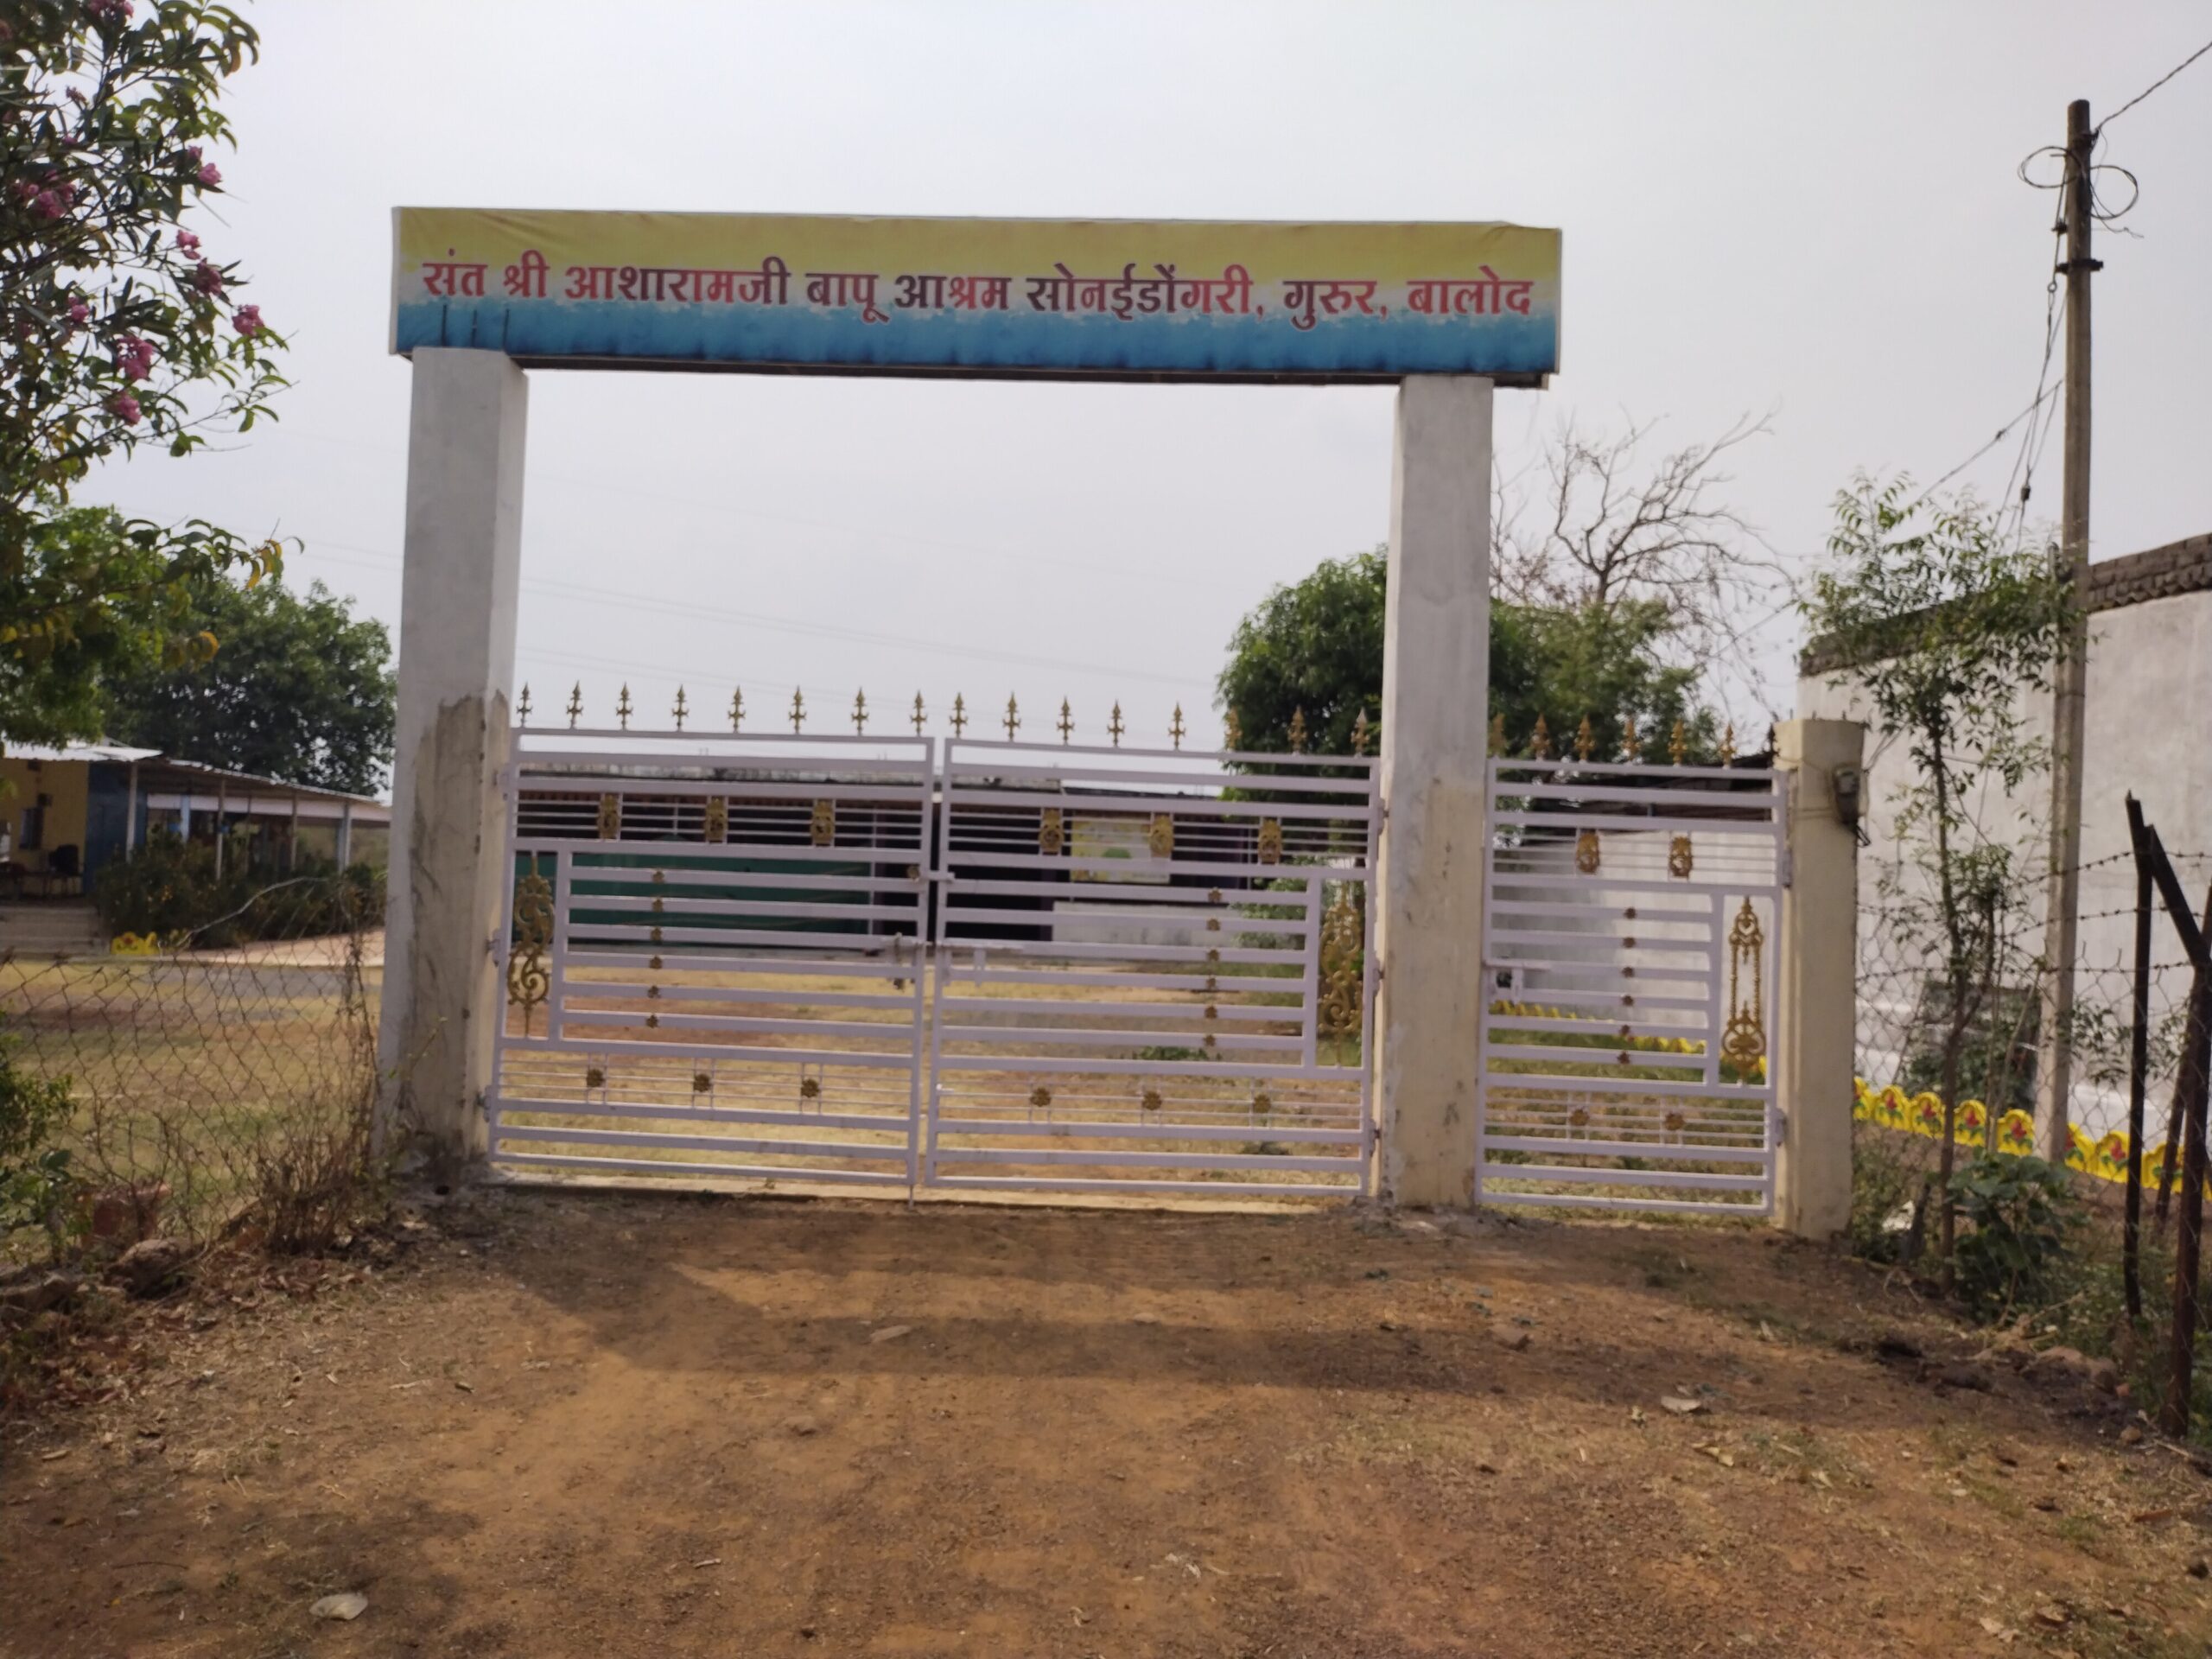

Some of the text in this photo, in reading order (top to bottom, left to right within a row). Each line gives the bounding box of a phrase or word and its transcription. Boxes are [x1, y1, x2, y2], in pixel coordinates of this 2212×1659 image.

[423, 248, 1535, 330] संत श्री आशारामजी बापू आश्रम सोनईडोंगरी, गुरुर, बालोद
